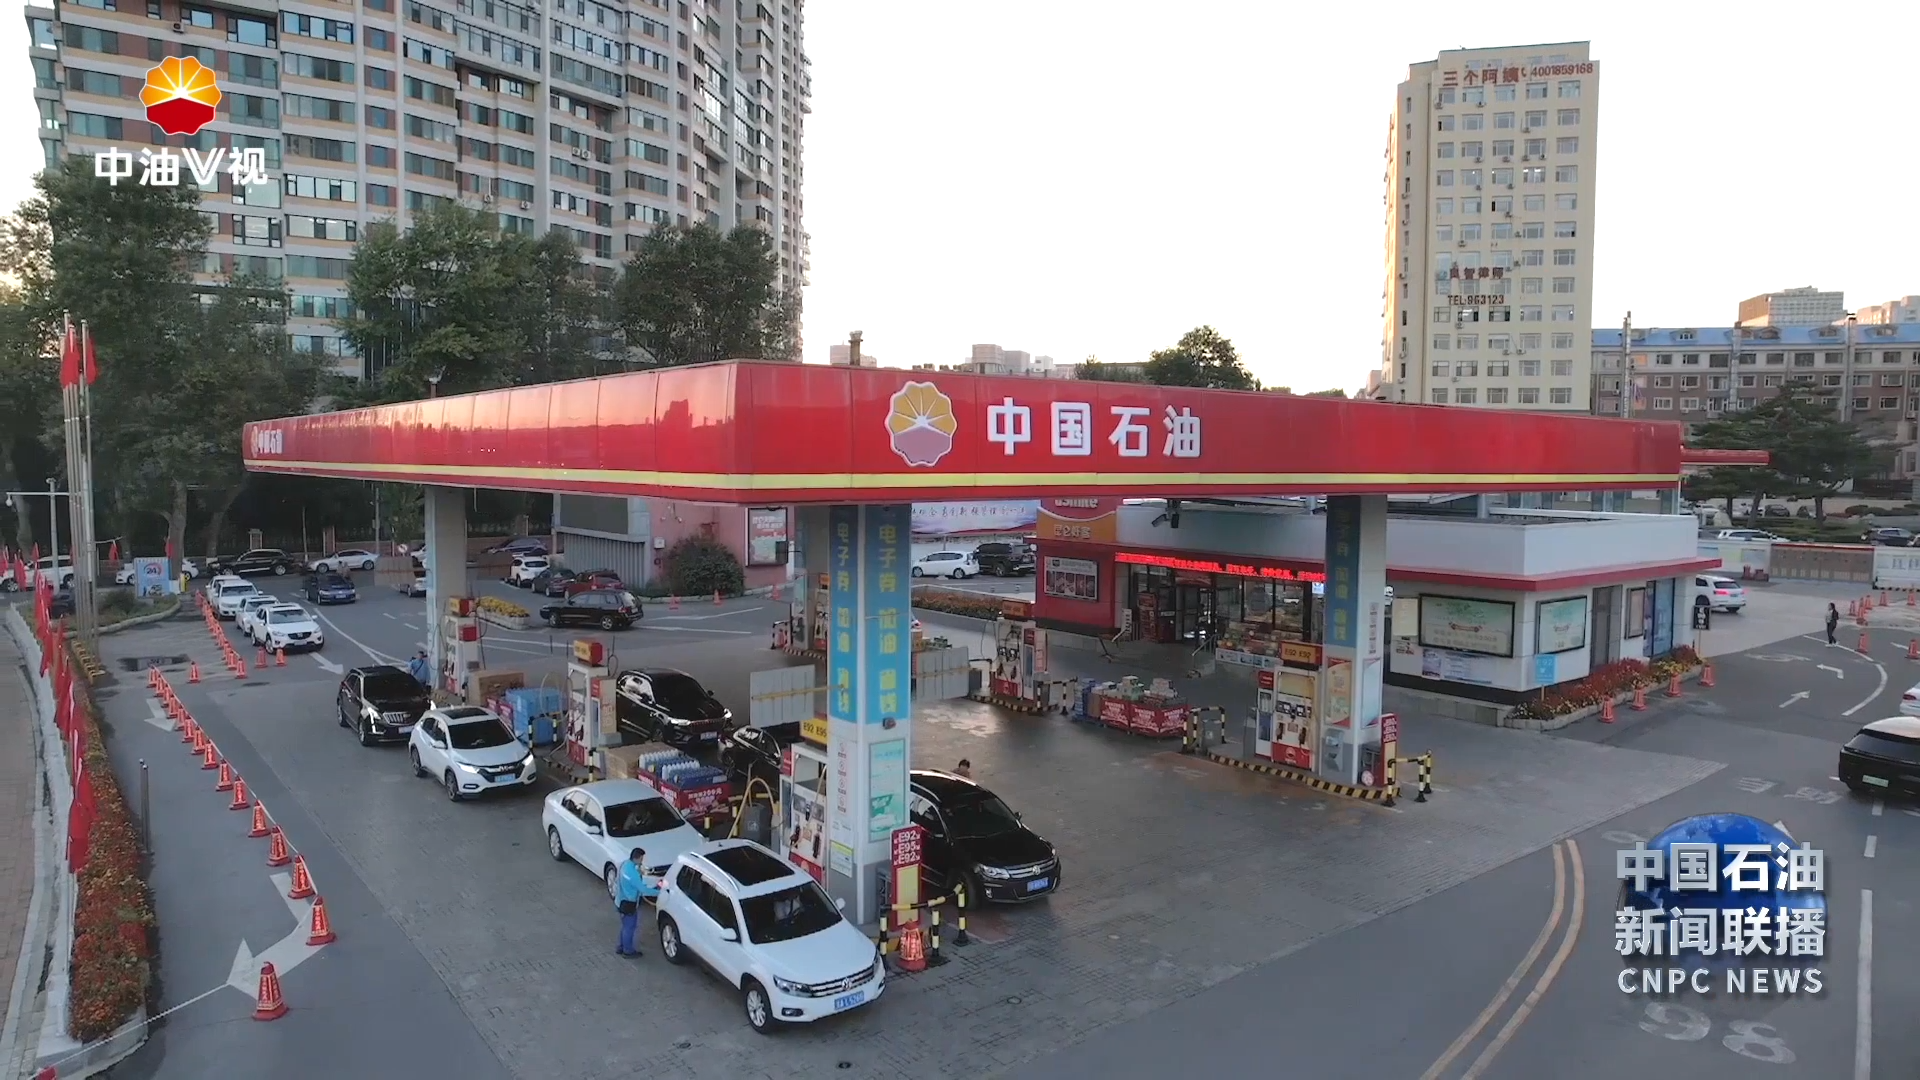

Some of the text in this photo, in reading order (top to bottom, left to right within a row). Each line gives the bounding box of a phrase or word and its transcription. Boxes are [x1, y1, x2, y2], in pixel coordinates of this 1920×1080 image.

[1530, 63, 1594, 78] 4001859168
[986, 396, 1200, 458] 中国石油
[898, 830, 916, 844] E92
[898, 841, 916, 854] E95
[898, 851, 916, 865] E92
